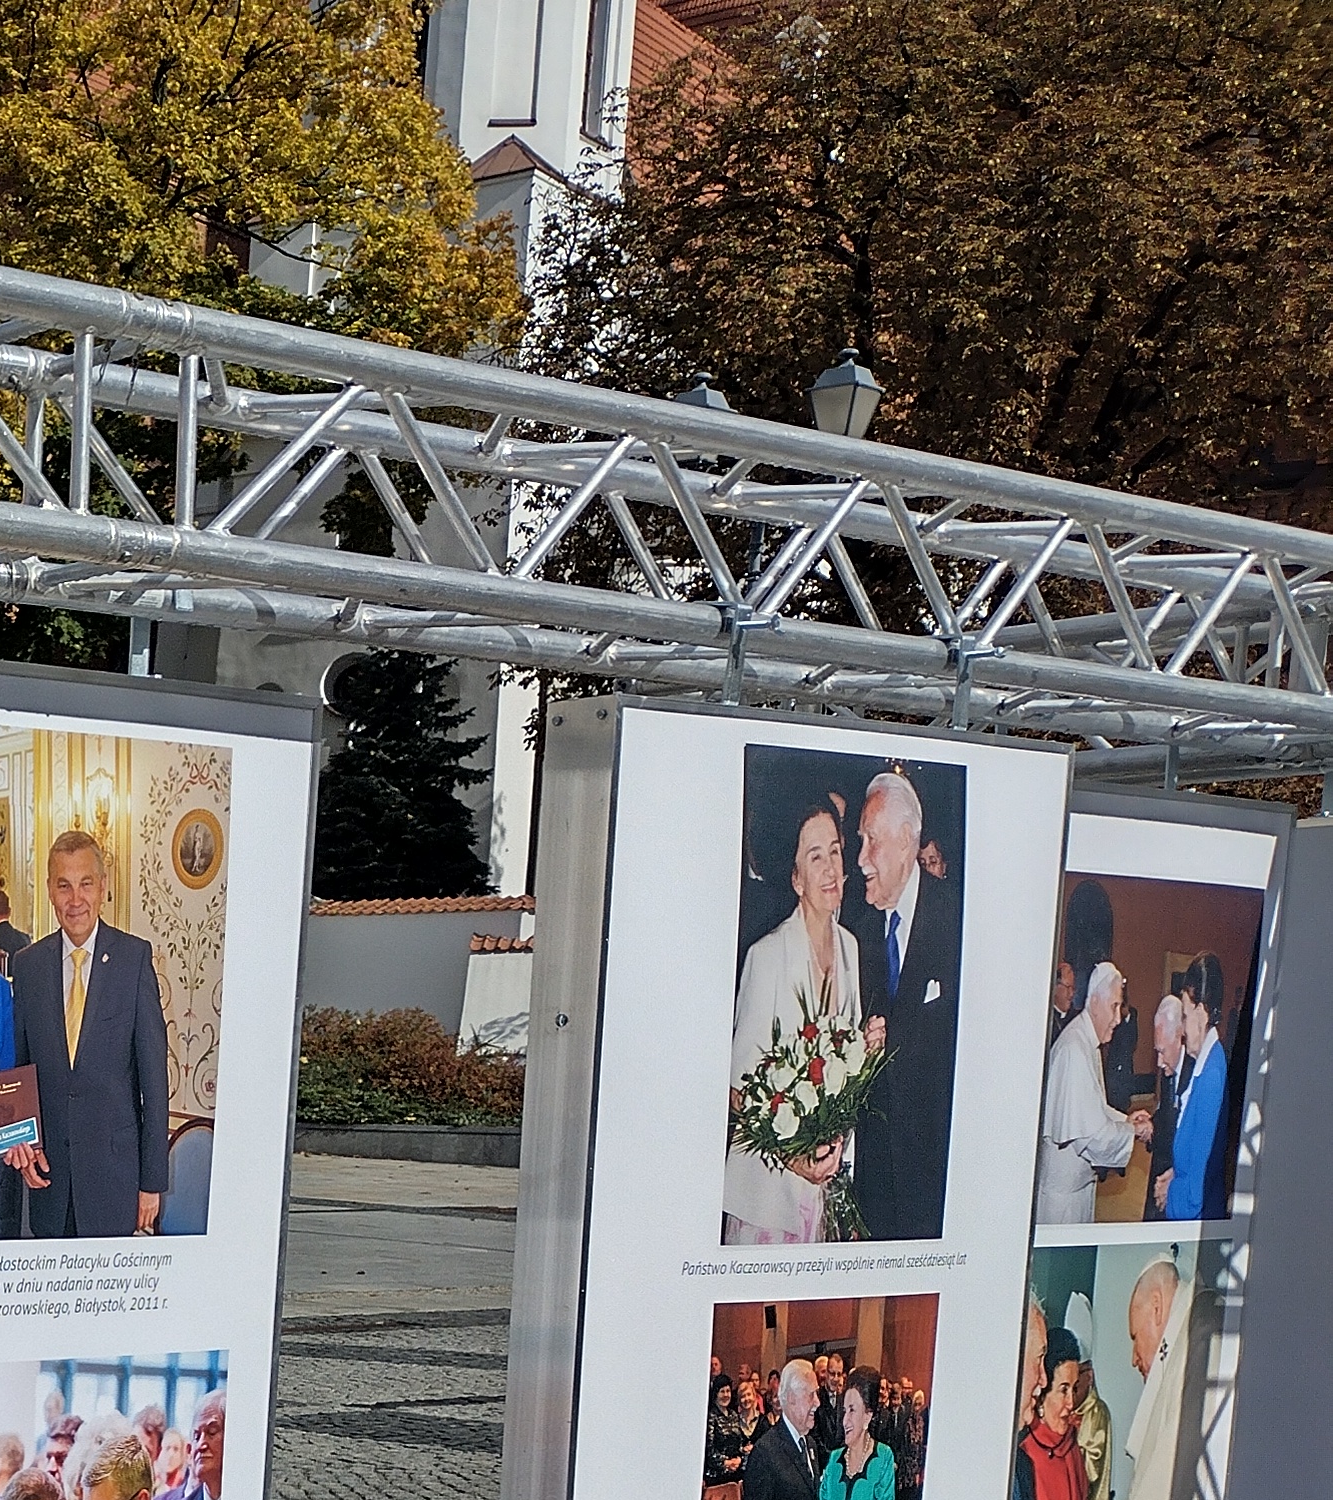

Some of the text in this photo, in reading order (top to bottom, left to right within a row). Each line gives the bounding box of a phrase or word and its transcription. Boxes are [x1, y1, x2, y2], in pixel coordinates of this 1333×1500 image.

[59, 1253, 111, 1273] Pałacyku
[113, 1252, 172, 1271] Gościnnym
[3, 1282, 14, 1294] w
[16, 1278, 43, 1293] dniu
[46, 1276, 94, 1292] nadania
[96, 1279, 132, 1294] nazwy
[134, 1274, 160, 1293] ulicy
[74, 1296, 127, 1317] Białystok,
[130, 1297, 159, 1311] 2011
[162, 1298, 168, 1309] r.
